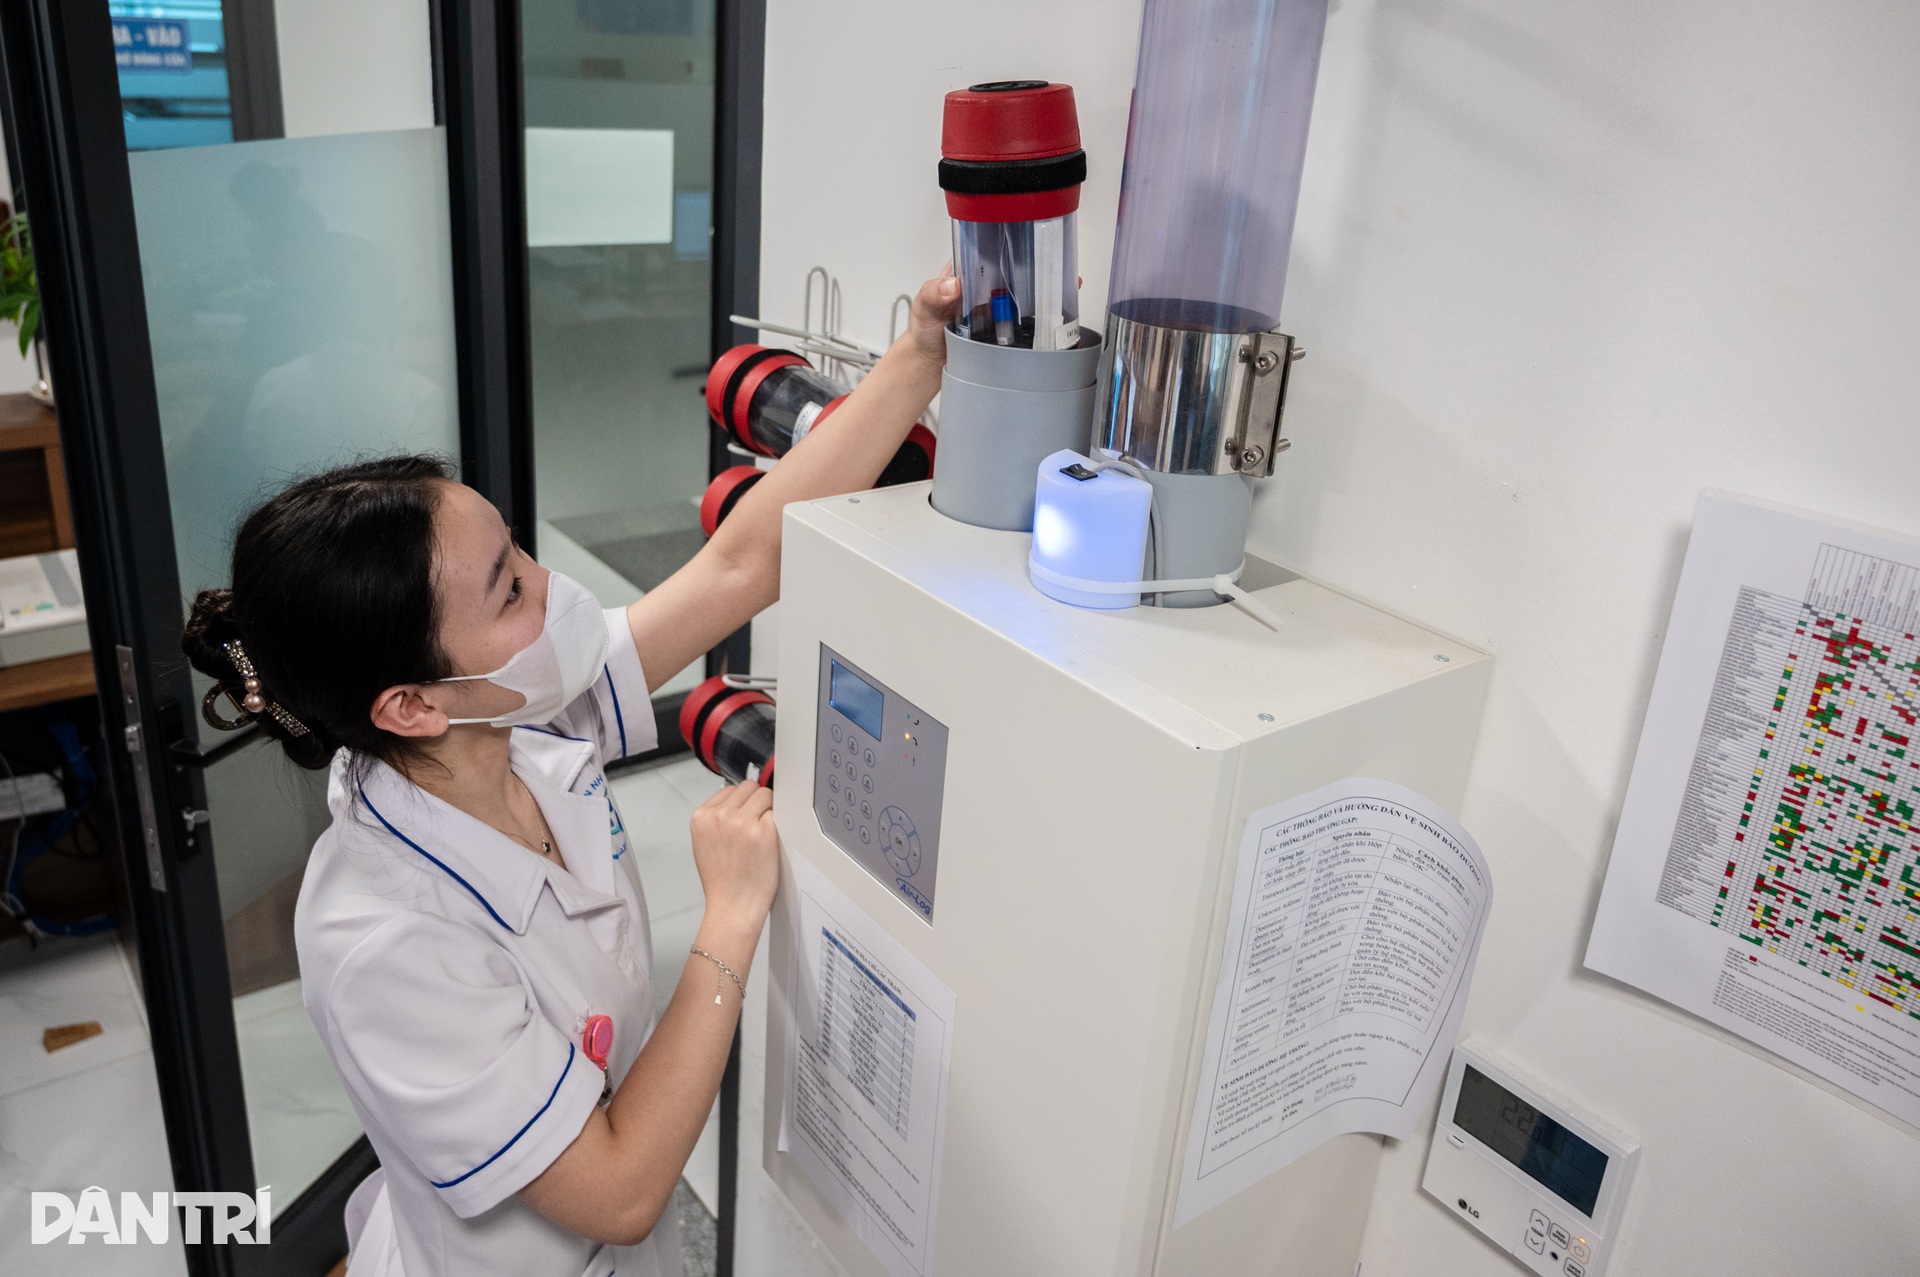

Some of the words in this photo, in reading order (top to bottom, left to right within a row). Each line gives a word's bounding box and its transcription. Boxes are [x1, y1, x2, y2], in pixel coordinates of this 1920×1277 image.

[895, 837, 903, 846] OK
[900, 884, 930, 914] Air-Log
[1468, 1206, 1479, 1219] LG
[1531, 1226, 1544, 1238] TEMP
[1552, 1232, 1567, 1245] SPEED
